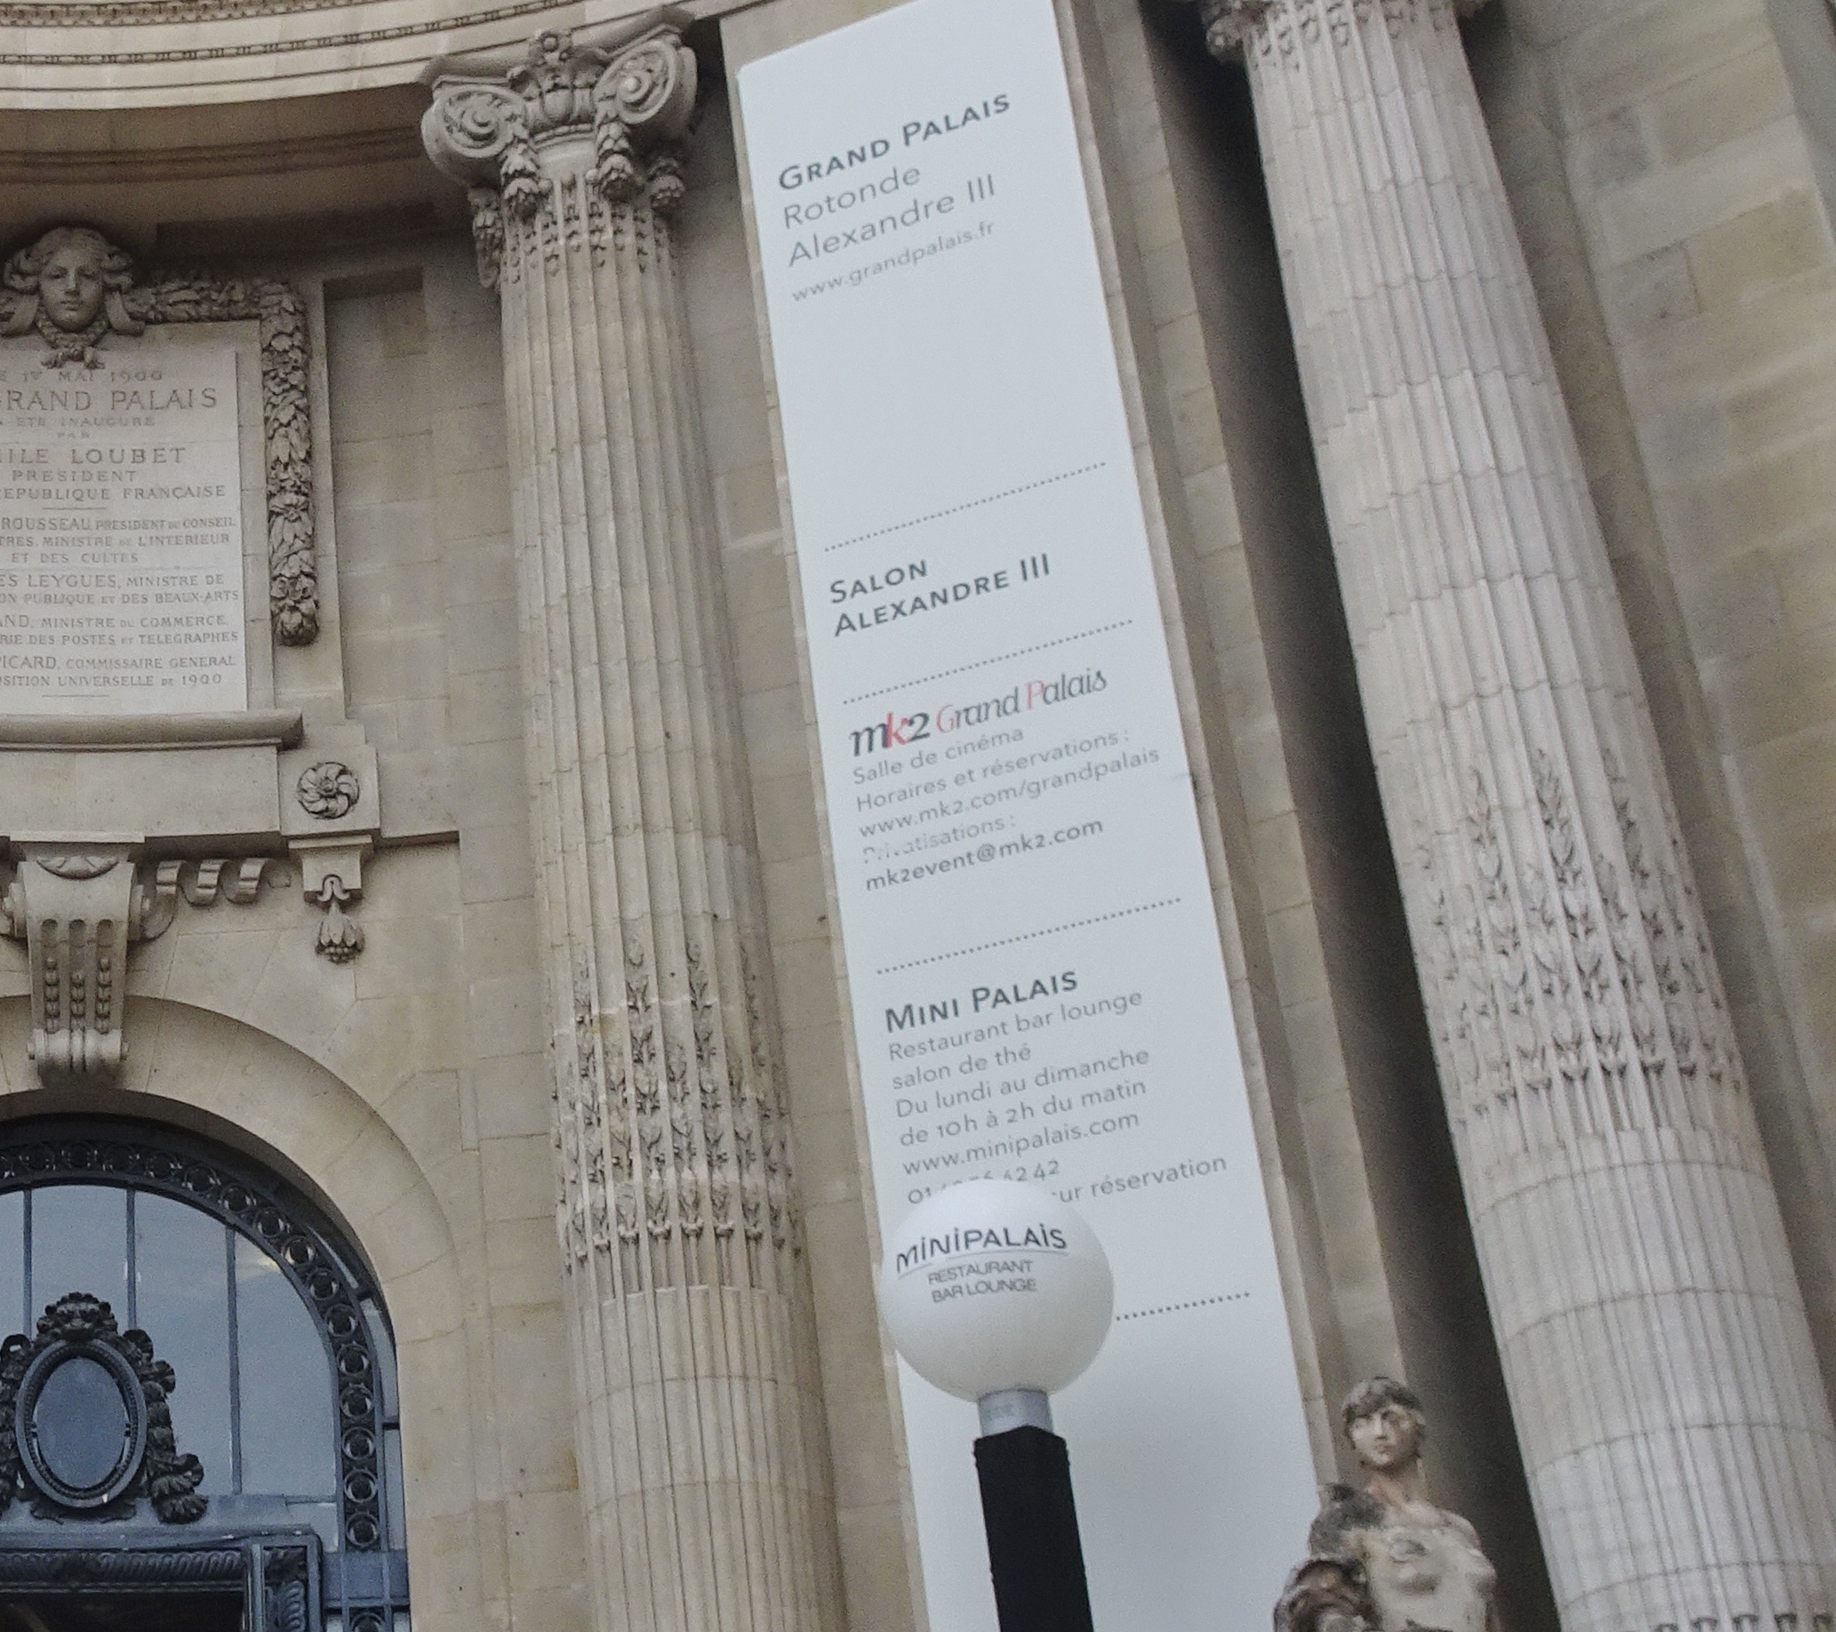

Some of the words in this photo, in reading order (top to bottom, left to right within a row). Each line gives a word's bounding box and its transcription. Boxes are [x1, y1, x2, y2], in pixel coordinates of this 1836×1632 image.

[778, 138, 890, 190] GRAND
[901, 93, 1010, 147] PALAIS
[783, 166, 920, 229] Rotonde
[788, 194, 954, 267] Alexandre
[966, 173, 995, 203] III
[791, 220, 992, 302] www.grandpalais.fr
[110, 387, 217, 411] PALAIS
[12, 469, 137, 482] PRESIDENT
[70, 447, 187, 465] LOUBET
[182, 517, 236, 529] CONSEIL
[11, 552, 29, 564] ET
[40, 552, 69, 564] DES
[126, 575, 198, 587] MINISTRE
[205, 573, 224, 585] DE
[829, 559, 927, 604] SALON
[833, 569, 1009, 637] ALEXANDRE
[1019, 552, 1050, 582] III
[41, 617, 115, 628] MINISTRE
[62, 634, 115, 646] POSTES
[181, 673, 222, 685] 1900
[850, 711, 931, 757] mk2
[935, 685, 1020, 732] Grand
[1026, 667, 1107, 709] Palais
[852, 758, 903, 785] Salle
[909, 749, 937, 769] de
[944, 728, 1024, 760] cinéma
[855, 777, 947, 812] Horaires
[953, 768, 975, 787] et
[858, 748, 1160, 838] www.mk2.com/grandpalais
[865, 819, 1103, 891] mk2event@mk2.com
[884, 997, 959, 1033] MINI
[971, 970, 1078, 1013] PALAIS
[887, 1020, 1008, 1061] Restaurant
[1014, 1011, 1053, 1032] bar
[1059, 991, 1142, 1021] lounge
[891, 1064, 951, 1090] salon
[958, 1053, 988, 1075] de
[994, 1045, 1031, 1066] thé
[895, 1097, 928, 1118] Du
[934, 1079, 992, 1109] lundi
[999, 1077, 1026, 1095] au
[1033, 1048, 1149, 1087] dimanche
[898, 1125, 928, 1146] de
[936, 1112, 978, 1138] 10h
[985, 1108, 999, 1128] à
[1005, 1100, 1035, 1124] 2h
[1041, 1093, 1073, 1115] du
[1080, 1081, 1146, 1107] matin
[902, 1112, 1139, 1175] www.minipalais.com
[1032, 1159, 1059, 1181] 42
[1051, 1186, 1082, 1203] ur
[1090, 1157, 1227, 1197] réservation
[927, 1260, 1034, 1285] RESTAURANT
[932, 1285, 963, 1303] BAR
[966, 1278, 1038, 1296] LOUNGE
